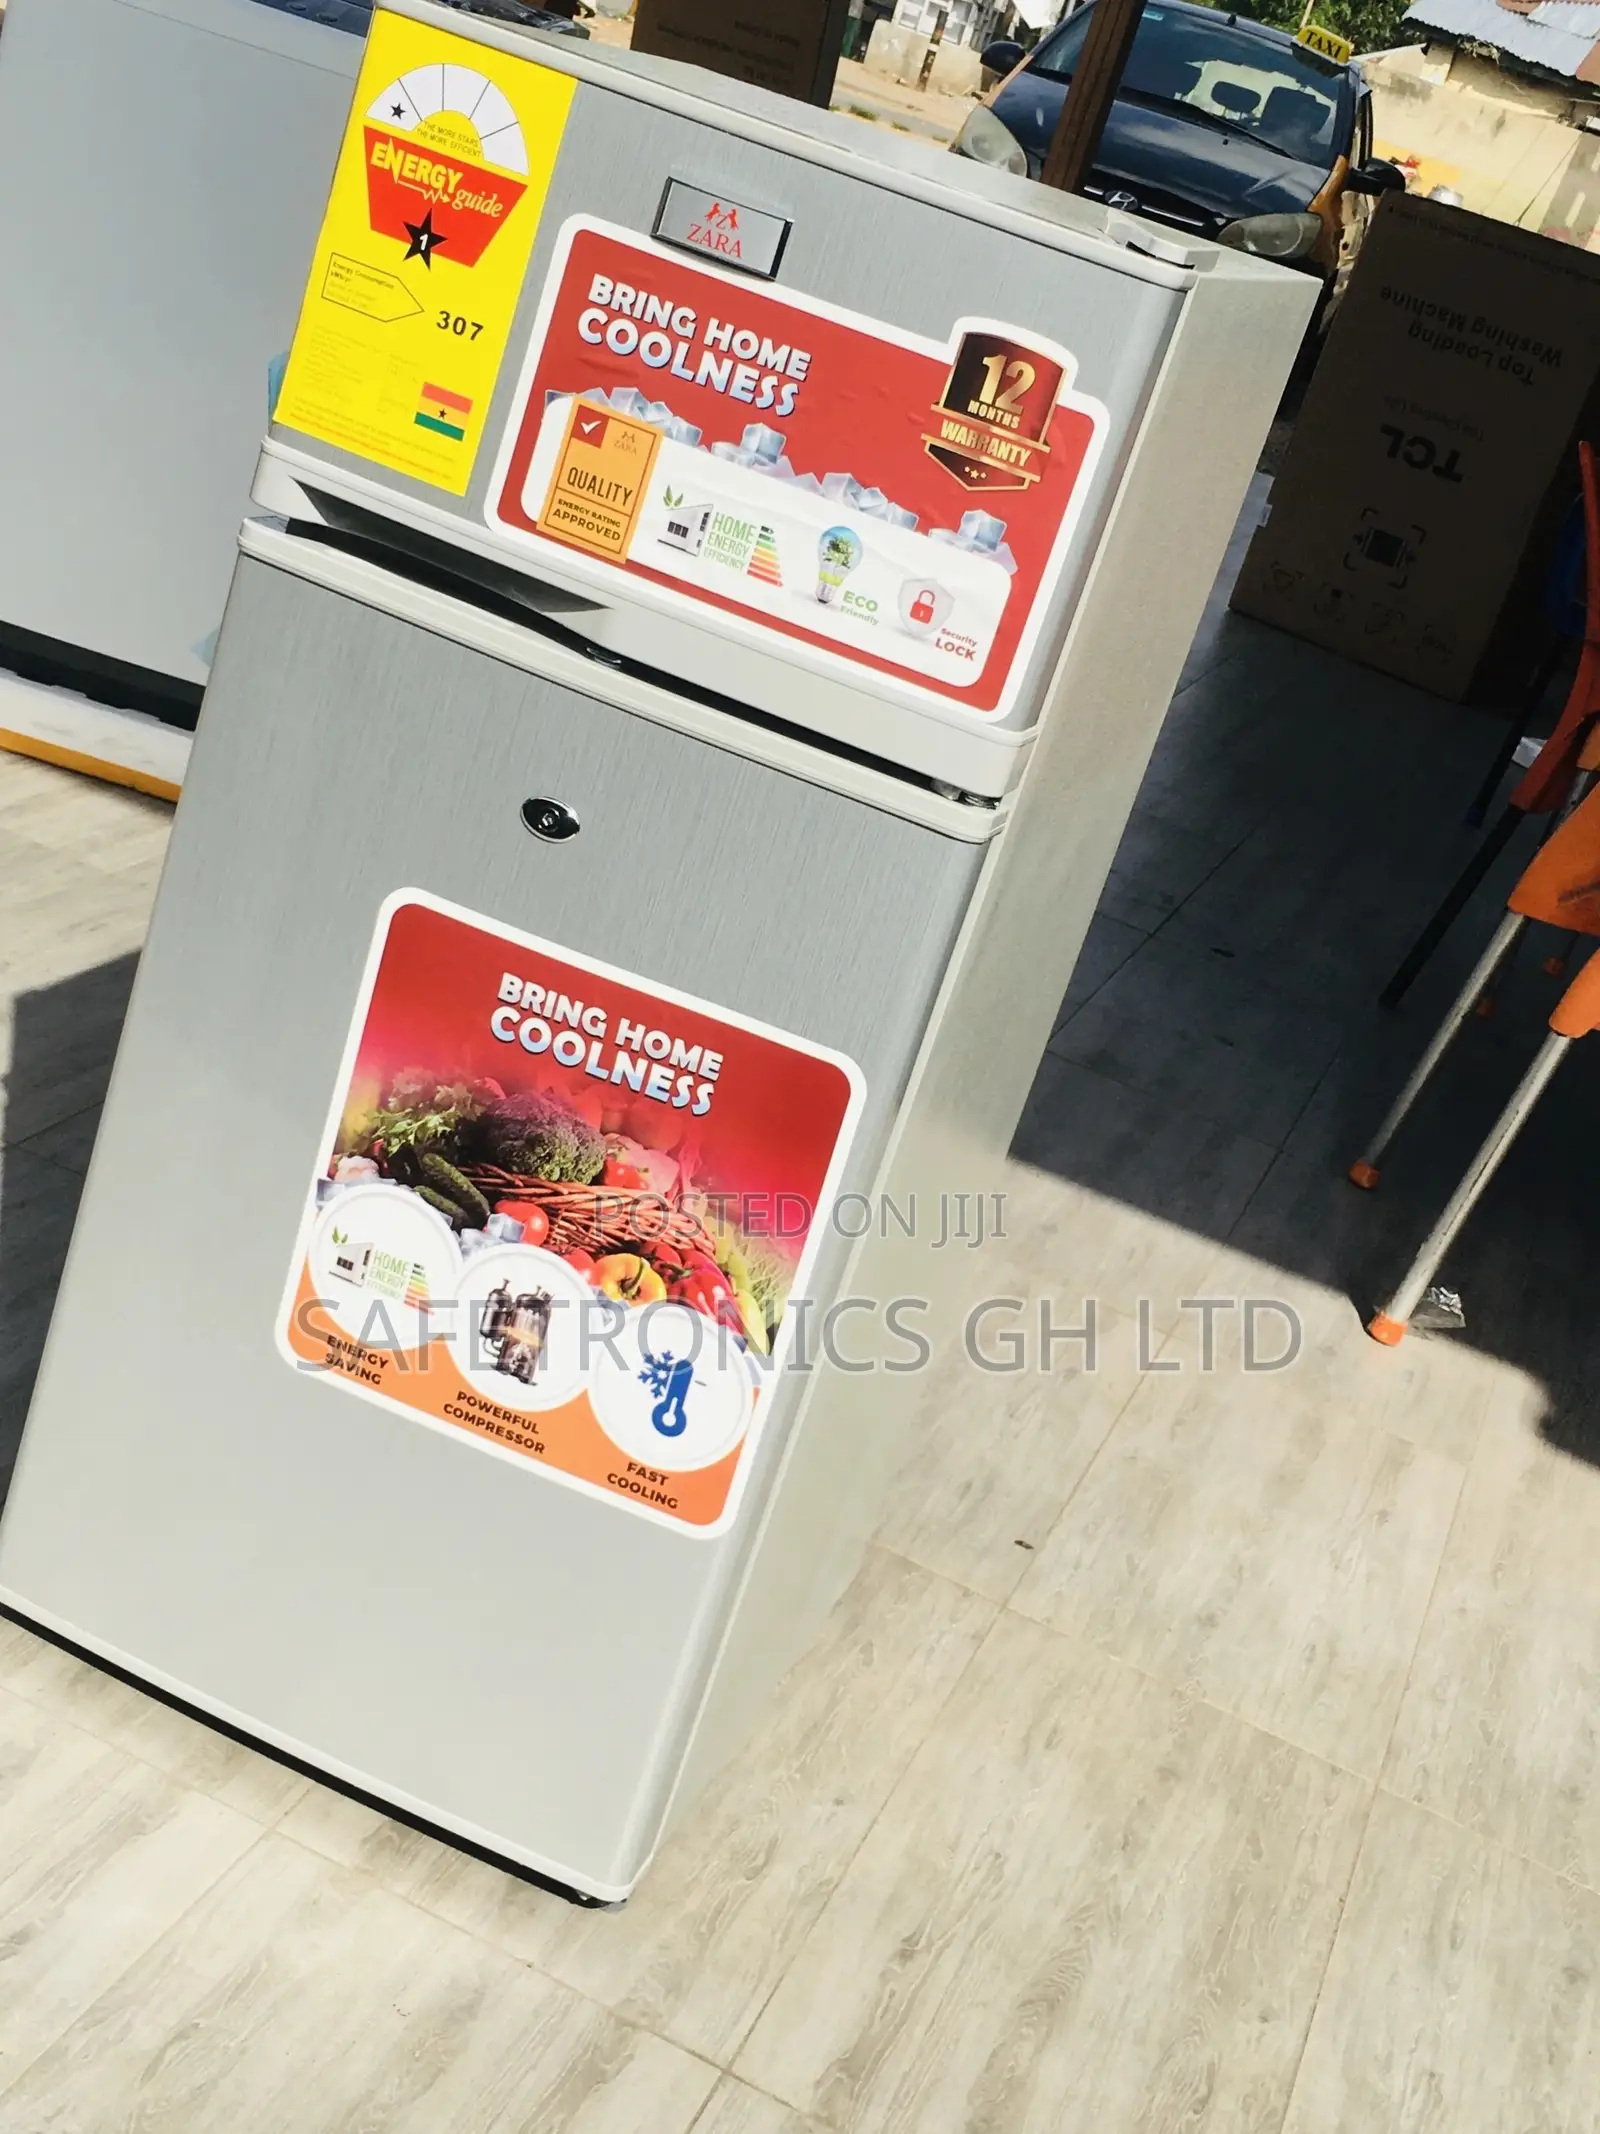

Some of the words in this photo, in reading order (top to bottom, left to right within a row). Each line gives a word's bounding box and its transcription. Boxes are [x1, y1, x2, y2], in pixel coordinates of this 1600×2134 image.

[1304, 29, 1343, 58] TAXI
[370, 137, 463, 194] ENERGY
[451, 188, 503, 218] guide
[420, 233, 429, 251] 1
[686, 223, 742, 259] ZARA
[436, 310, 484, 341] 307
[1380, 285, 1467, 333] Machine
[588, 273, 697, 339] BRING
[703, 317, 812, 381] HOME
[1470, 315, 1563, 367] Washing
[578, 307, 799, 416] COOLNESS
[1408, 320, 1494, 369] Loading
[978, 354, 1036, 415] 12
[1498, 354, 1534, 386] Top
[967, 401, 1021, 429] MONTHS
[940, 419, 1032, 467] WARRANTY
[1380, 423, 1464, 482] TCL
[567, 466, 633, 507] QUALITY
[552, 508, 621, 542] APPROVED
[557, 498, 591, 518] ENERGY
[591, 511, 621, 529] RATING
[711, 511, 757, 544] HOME
[707, 532, 750, 559] ENERGY
[839, 605, 880, 626] Friendly
[843, 590, 879, 612] ECO
[935, 637, 977, 661] LOCK
[940, 628, 978, 647] Security
[497, 972, 608, 1038] BRING
[615, 1018, 724, 1081] HOME
[490, 1006, 715, 1116] COOLNESS
[373, 1250, 409, 1277] HOME
[327, 1334, 389, 1369] ENERGY
[325, 1353, 382, 1385] SAVING
[443, 1403, 546, 1454] COMPRESSOR
[456, 1391, 540, 1434] POWERFUL
[606, 1472, 679, 1509] COOLING
[627, 1461, 669, 1486] FAST
